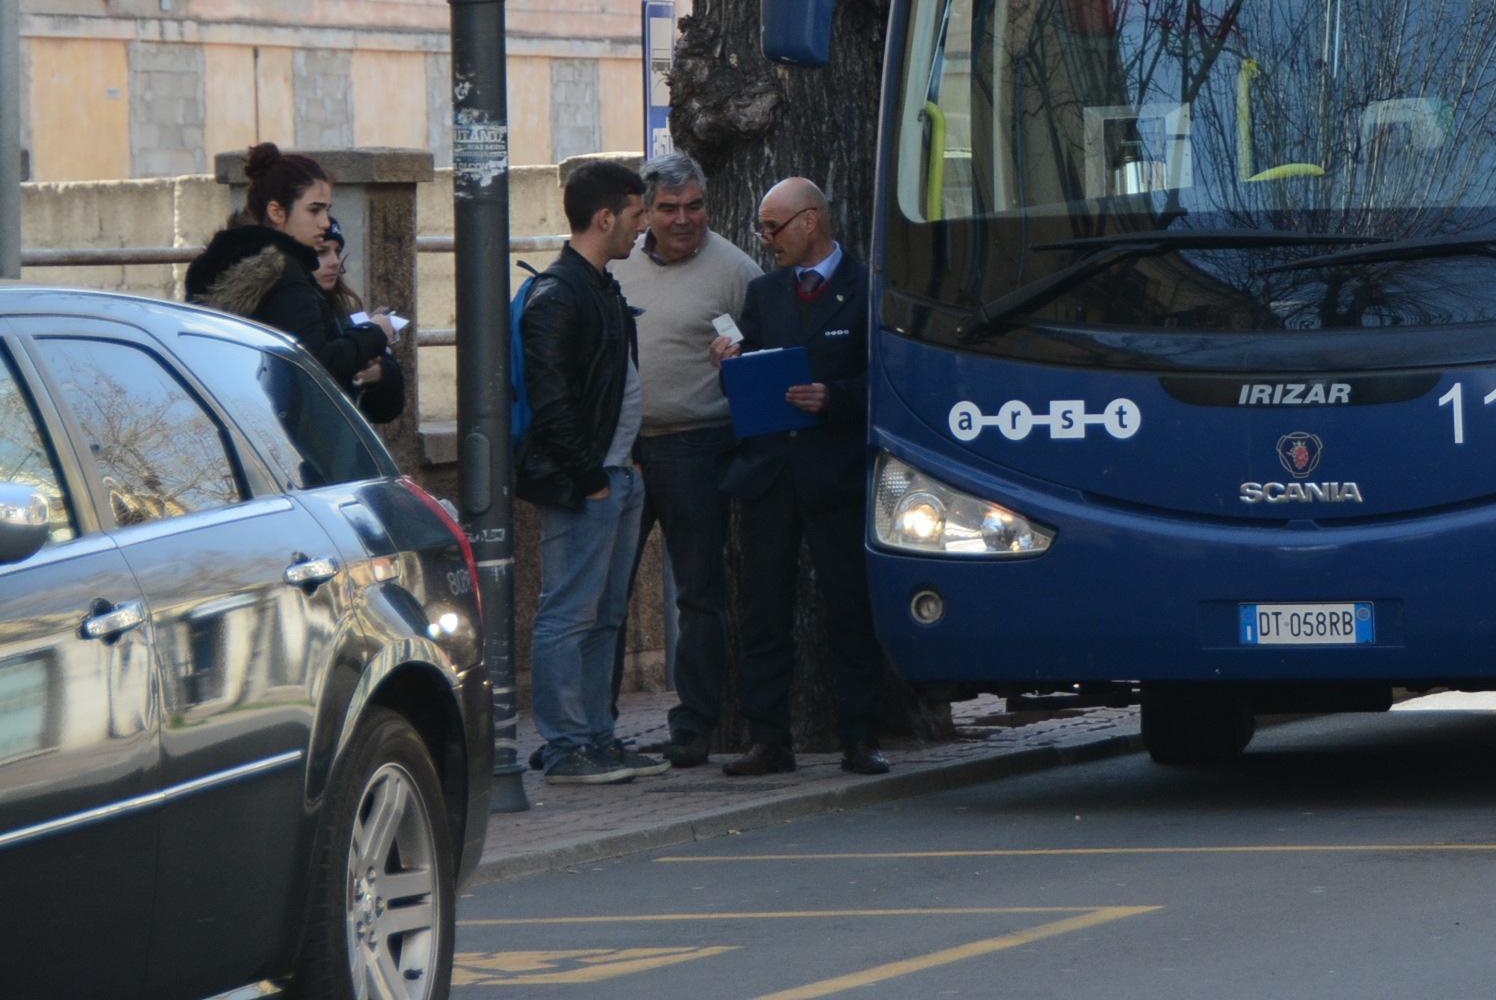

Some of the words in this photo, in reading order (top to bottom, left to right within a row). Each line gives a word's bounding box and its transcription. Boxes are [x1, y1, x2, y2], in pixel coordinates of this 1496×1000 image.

[1238, 383, 1352, 405] IRIZAR
[955, 402, 1131, 433] arst
[1240, 482, 1364, 503] SCANIA
[1259, 611, 1283, 637] DT
[1289, 611, 1354, 637] 058RB
